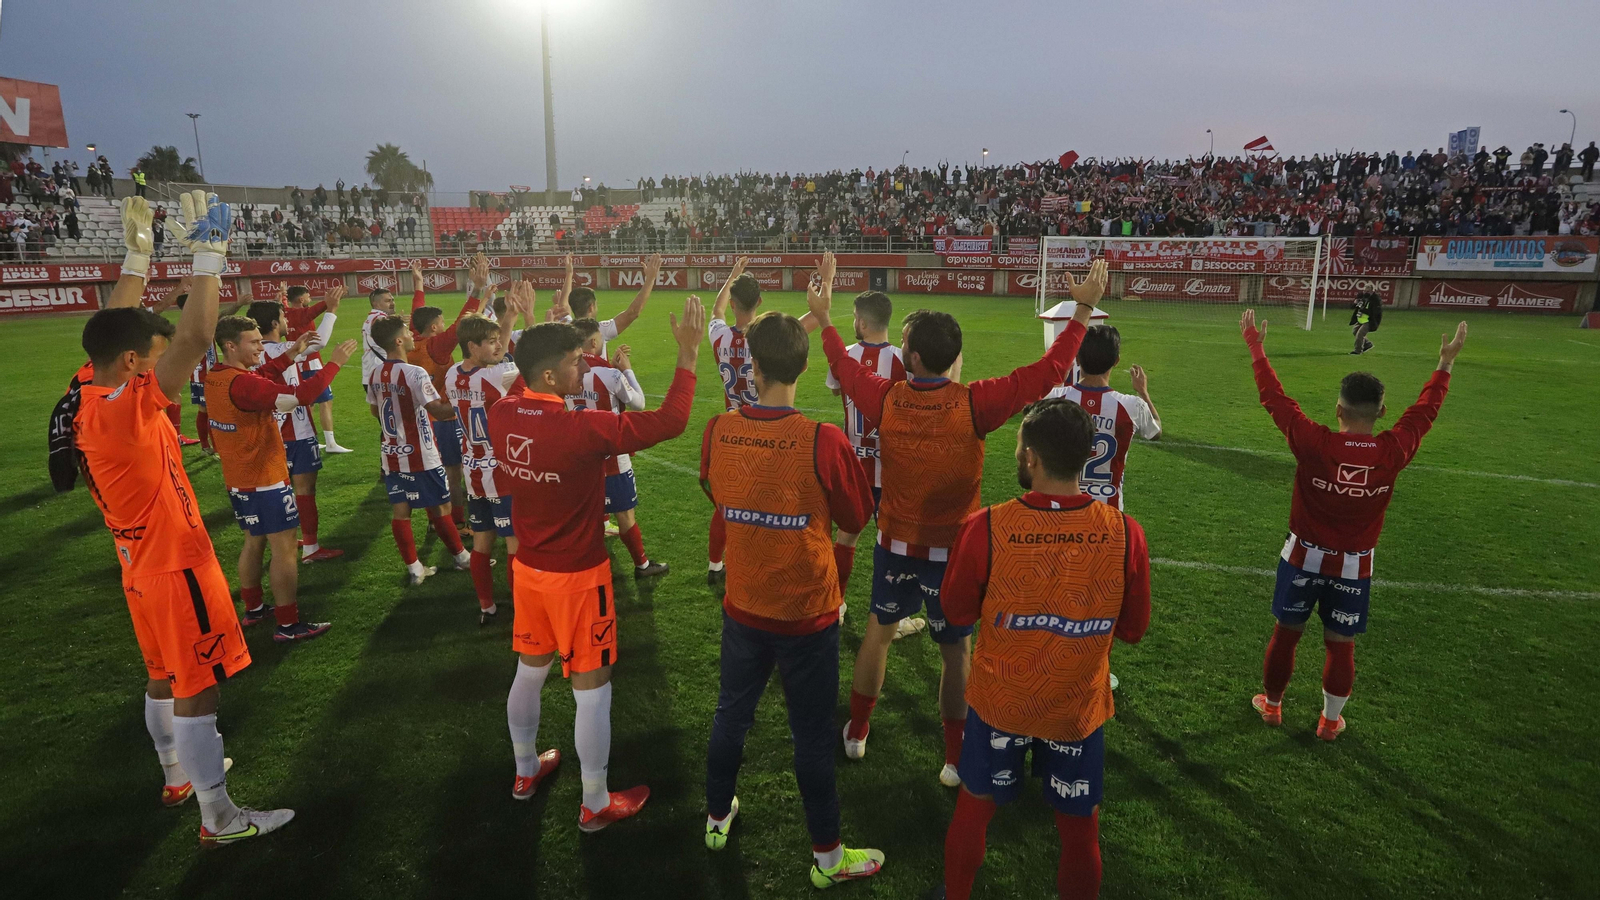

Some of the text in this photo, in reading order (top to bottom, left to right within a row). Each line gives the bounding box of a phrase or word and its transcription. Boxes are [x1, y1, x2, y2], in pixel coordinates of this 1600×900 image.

[1447, 240, 1545, 260] GUAPITAKITOS
[270, 260, 336, 273] Calle Trece
[610, 256, 640, 265] apymeal
[947, 256, 993, 265] opivision
[998, 256, 1039, 266] opivisio
[1204, 260, 1256, 271] BESOCCER
[3, 271, 49, 280] APOLO
[60, 270, 103, 279] APOLO
[618, 271, 679, 286] NAEX
[921, 271, 939, 280] Venta
[947, 273, 986, 282] El Cerezo
[905, 274, 940, 292] Pelayo
[957, 281, 976, 290] Rojo
[1300, 278, 1390, 291] SANGYONG
[1434, 291, 1483, 304] INAMER
[1503, 293, 1554, 306] INAMER
[717, 347, 735, 358] VAN
[893, 400, 960, 411] ALGECIRAS C.F.
[720, 434, 798, 450] ALGECIRAS C.F.
[1080, 432, 1118, 483] 2
[1312, 477, 1390, 497] GIVOVA
[727, 509, 808, 527] STOP-FLUID
[1008, 532, 1110, 544] ALGECIRAS C.F.
[1015, 615, 1112, 634] STOP-FLUID
[1050, 775, 1090, 799] HMM
